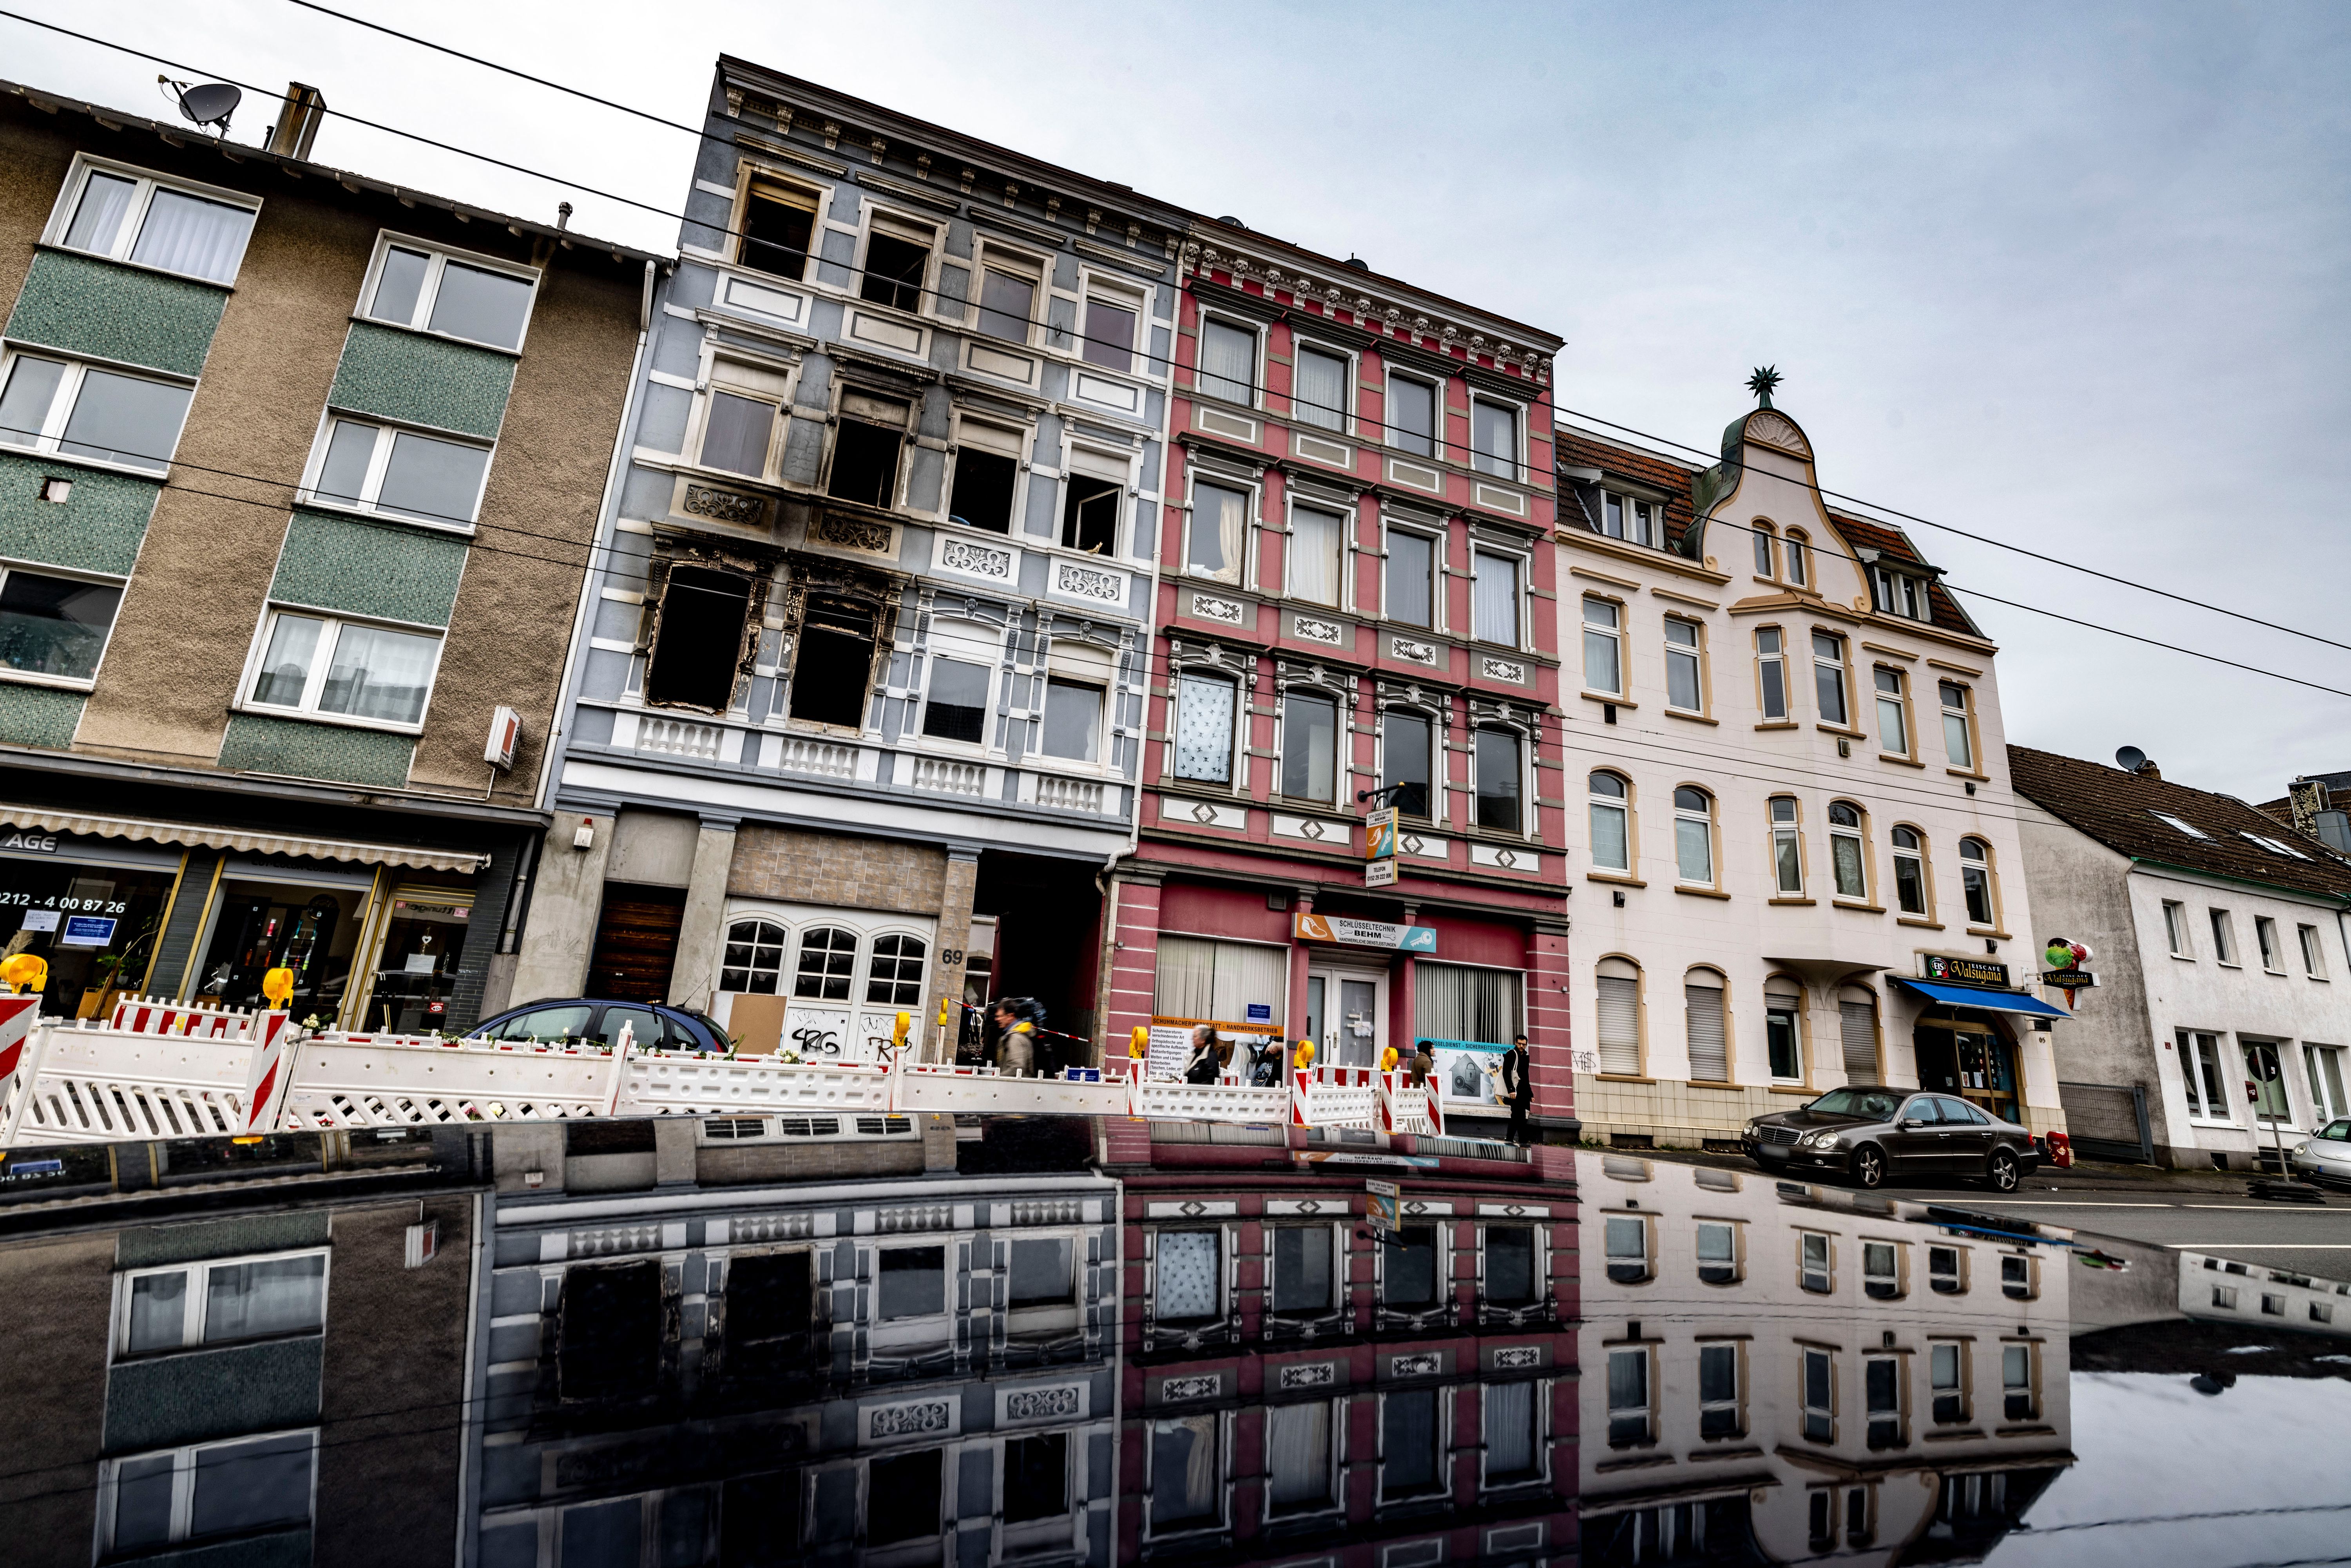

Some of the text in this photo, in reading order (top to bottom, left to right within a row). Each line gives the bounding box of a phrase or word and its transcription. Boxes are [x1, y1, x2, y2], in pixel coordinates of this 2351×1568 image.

[1369, 810, 1391, 819] SCHLÜSSELTECHNIK
[5, 833, 56, 851] AGE
[0, 892, 30, 905] 212
[45, 896, 55, 907] 4
[60, 898, 79, 909] 00
[83, 900, 103, 911] 87
[106, 902, 125, 913] 26
[1339, 920, 1396, 933] SCHLÜSSELTECHNIK
[1354, 930, 1381, 938] BEHM
[942, 949, 962, 965] 69
[1951, 961, 2002, 984] Valsugana
[1972, 963, 2000, 972] EISCAFÉ
[2044, 974, 2088, 984] Valsugana
[1226, 1024, 1277, 1034] HANDWERKSBETRIEB
[1421, 1040, 1461, 1048] ÜSSELDIENST
[1465, 1043, 1510, 1052] SICHERHEITSTECHNIK
